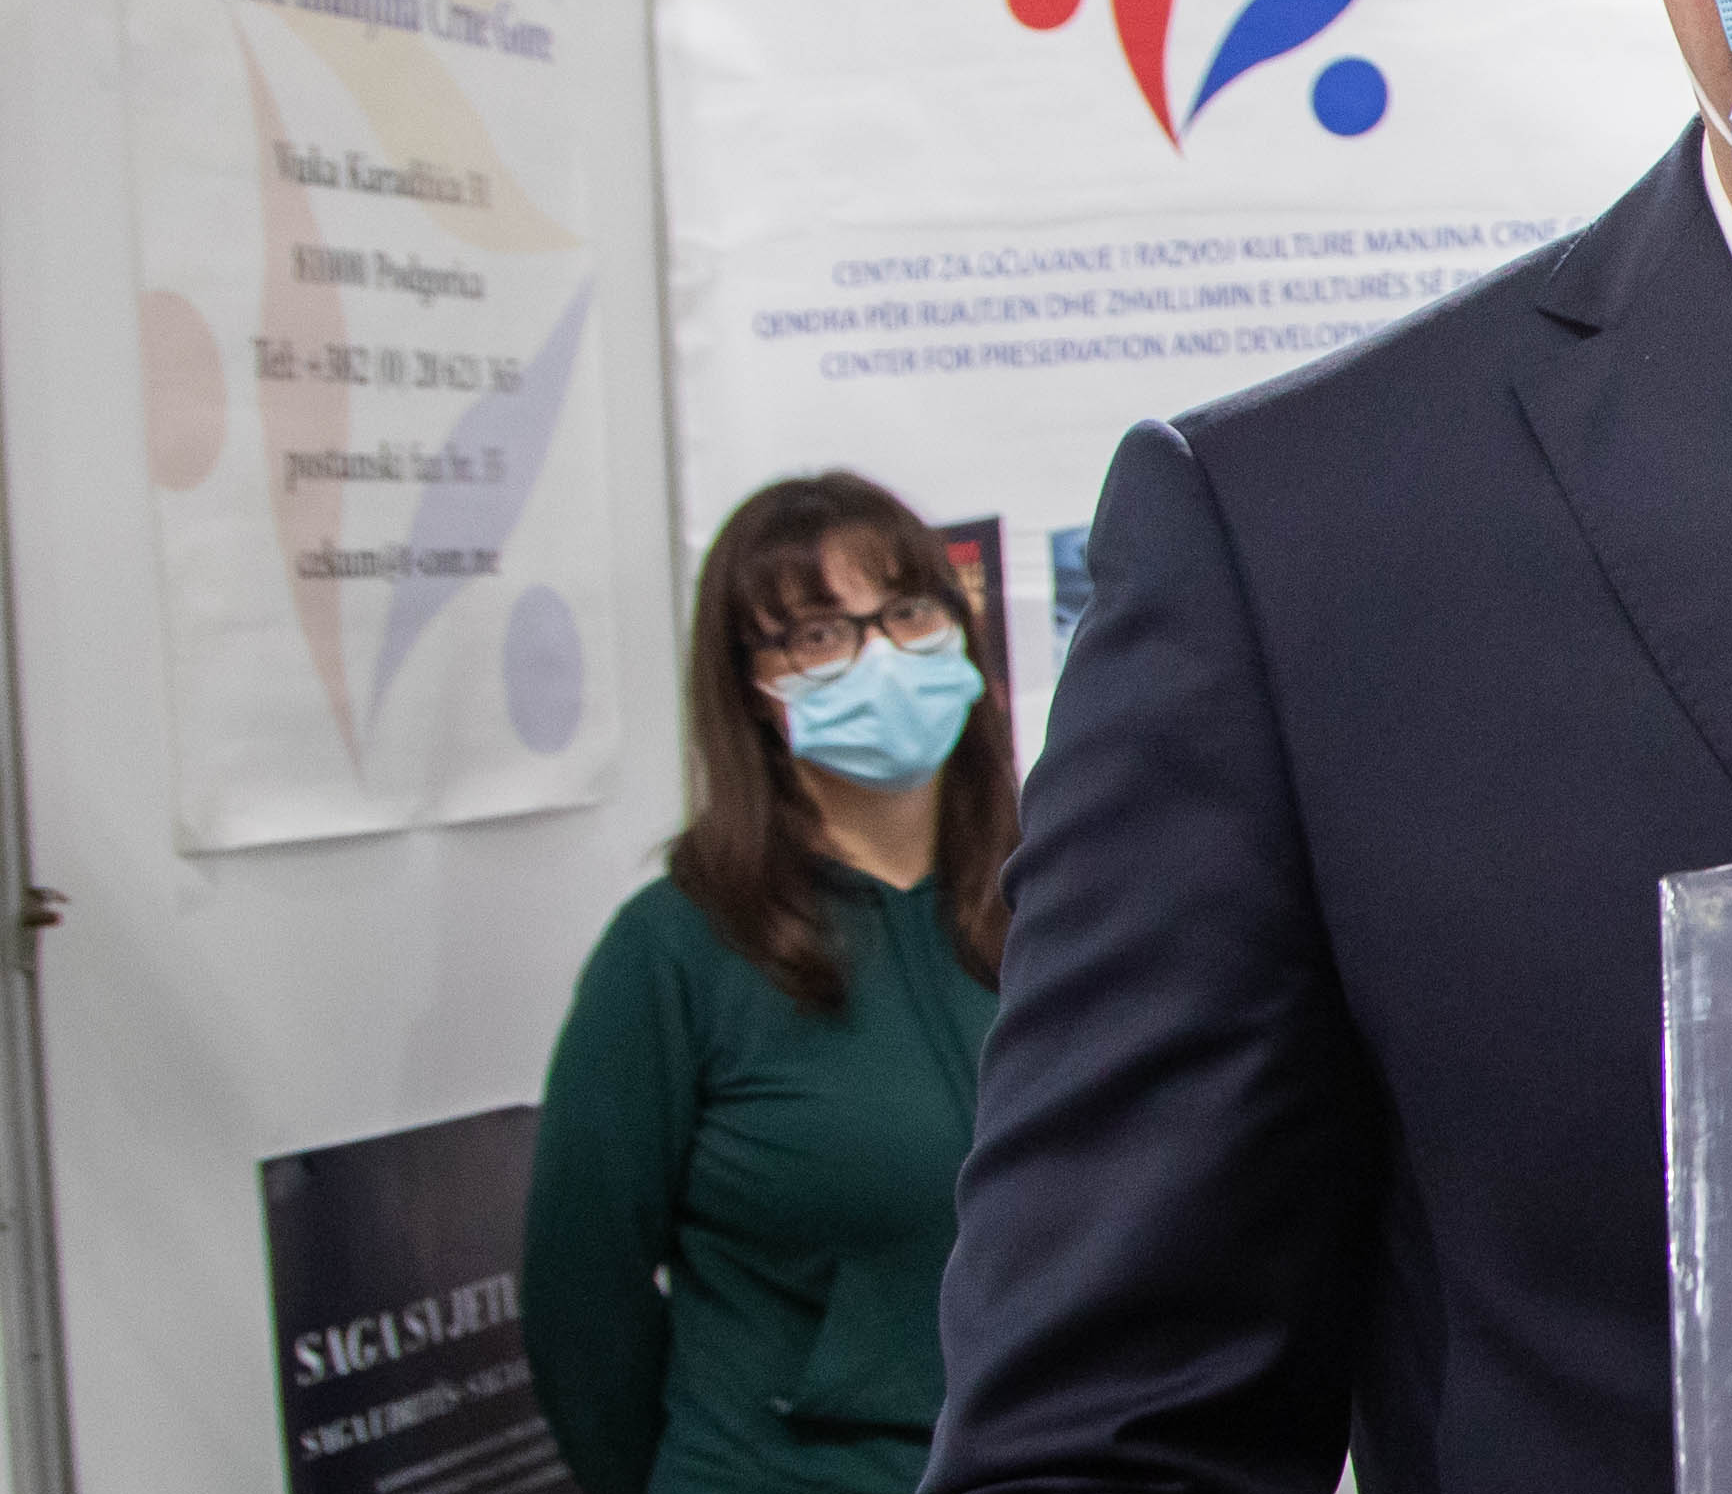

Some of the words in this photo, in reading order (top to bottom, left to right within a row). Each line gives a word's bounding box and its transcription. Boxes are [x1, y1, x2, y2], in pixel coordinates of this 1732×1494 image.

[1239, 230, 1354, 262] KULTURE
[1363, 224, 1484, 254] MANJINA
[820, 348, 915, 380] CENTER
[1171, 330, 1225, 357] AND
